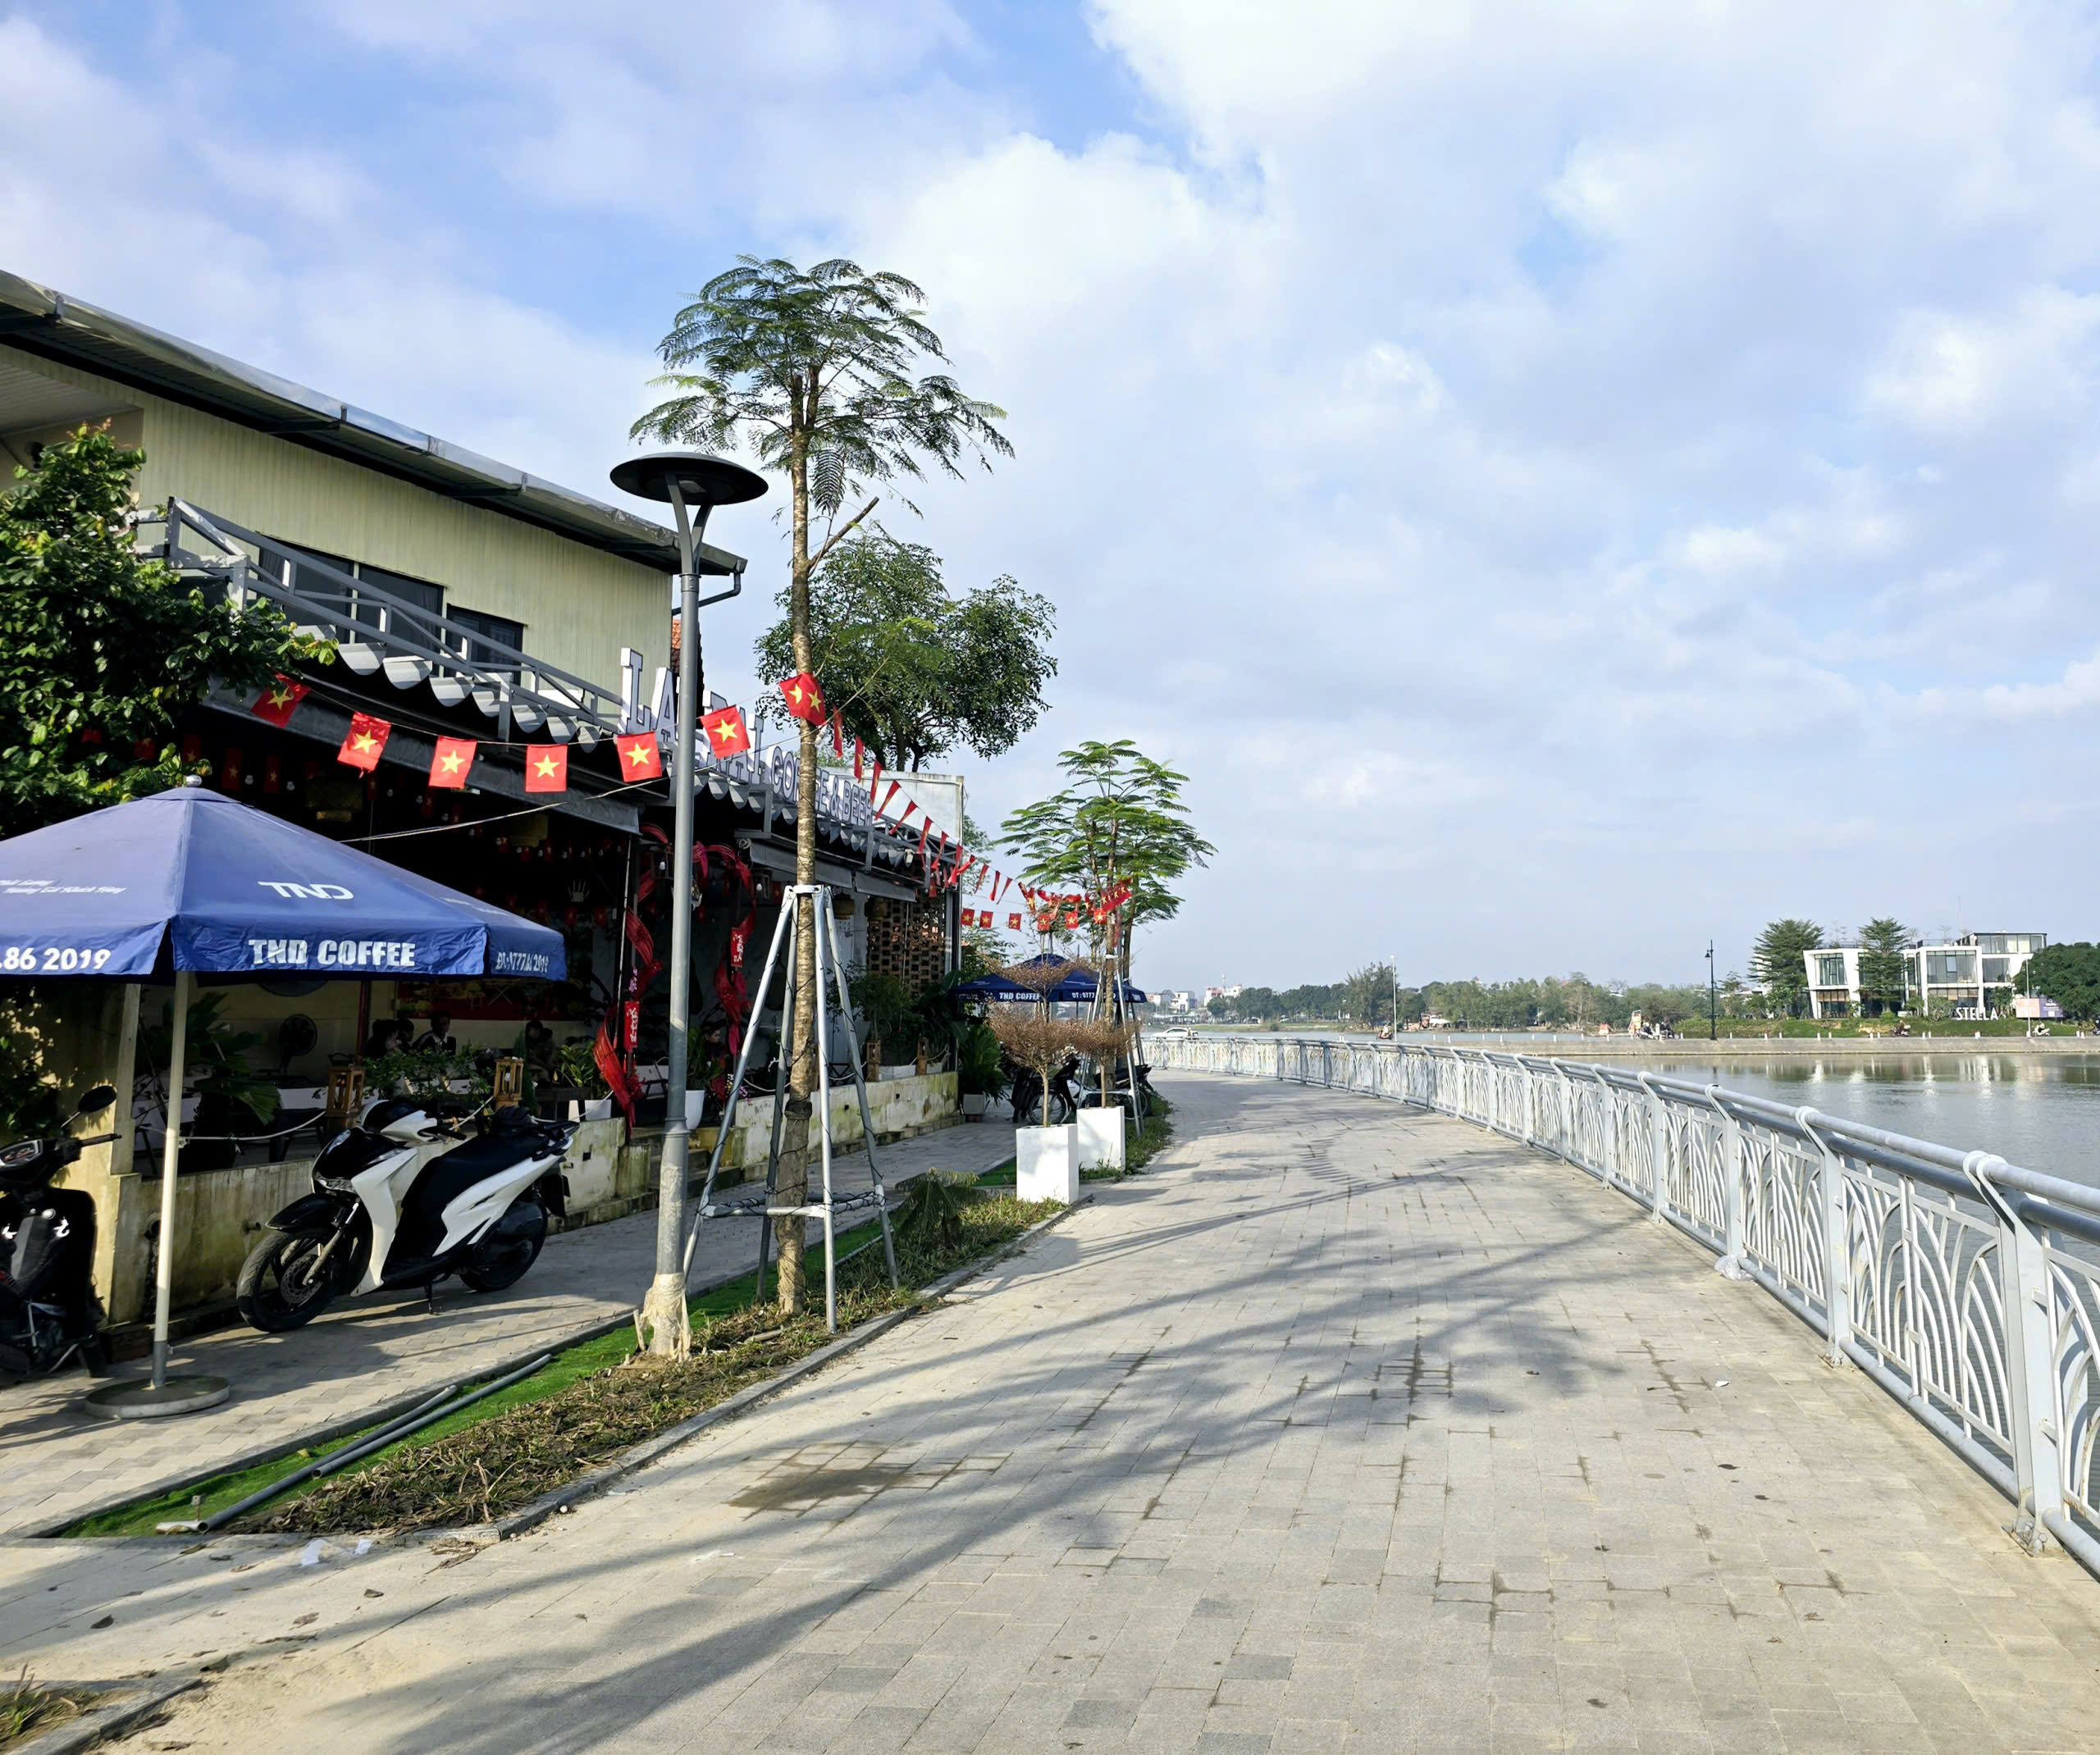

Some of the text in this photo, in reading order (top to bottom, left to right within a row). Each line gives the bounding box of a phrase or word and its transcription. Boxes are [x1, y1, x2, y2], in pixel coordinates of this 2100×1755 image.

[619, 648, 679, 745] LA
[769, 745, 829, 813] COFE
[842, 780, 873, 827] BEER
[258, 882, 354, 900] TND
[42, 947, 111, 970] 2019
[249, 939, 416, 967] TND COFFEE
[1956, 1007, 1998, 1020] STELLA
